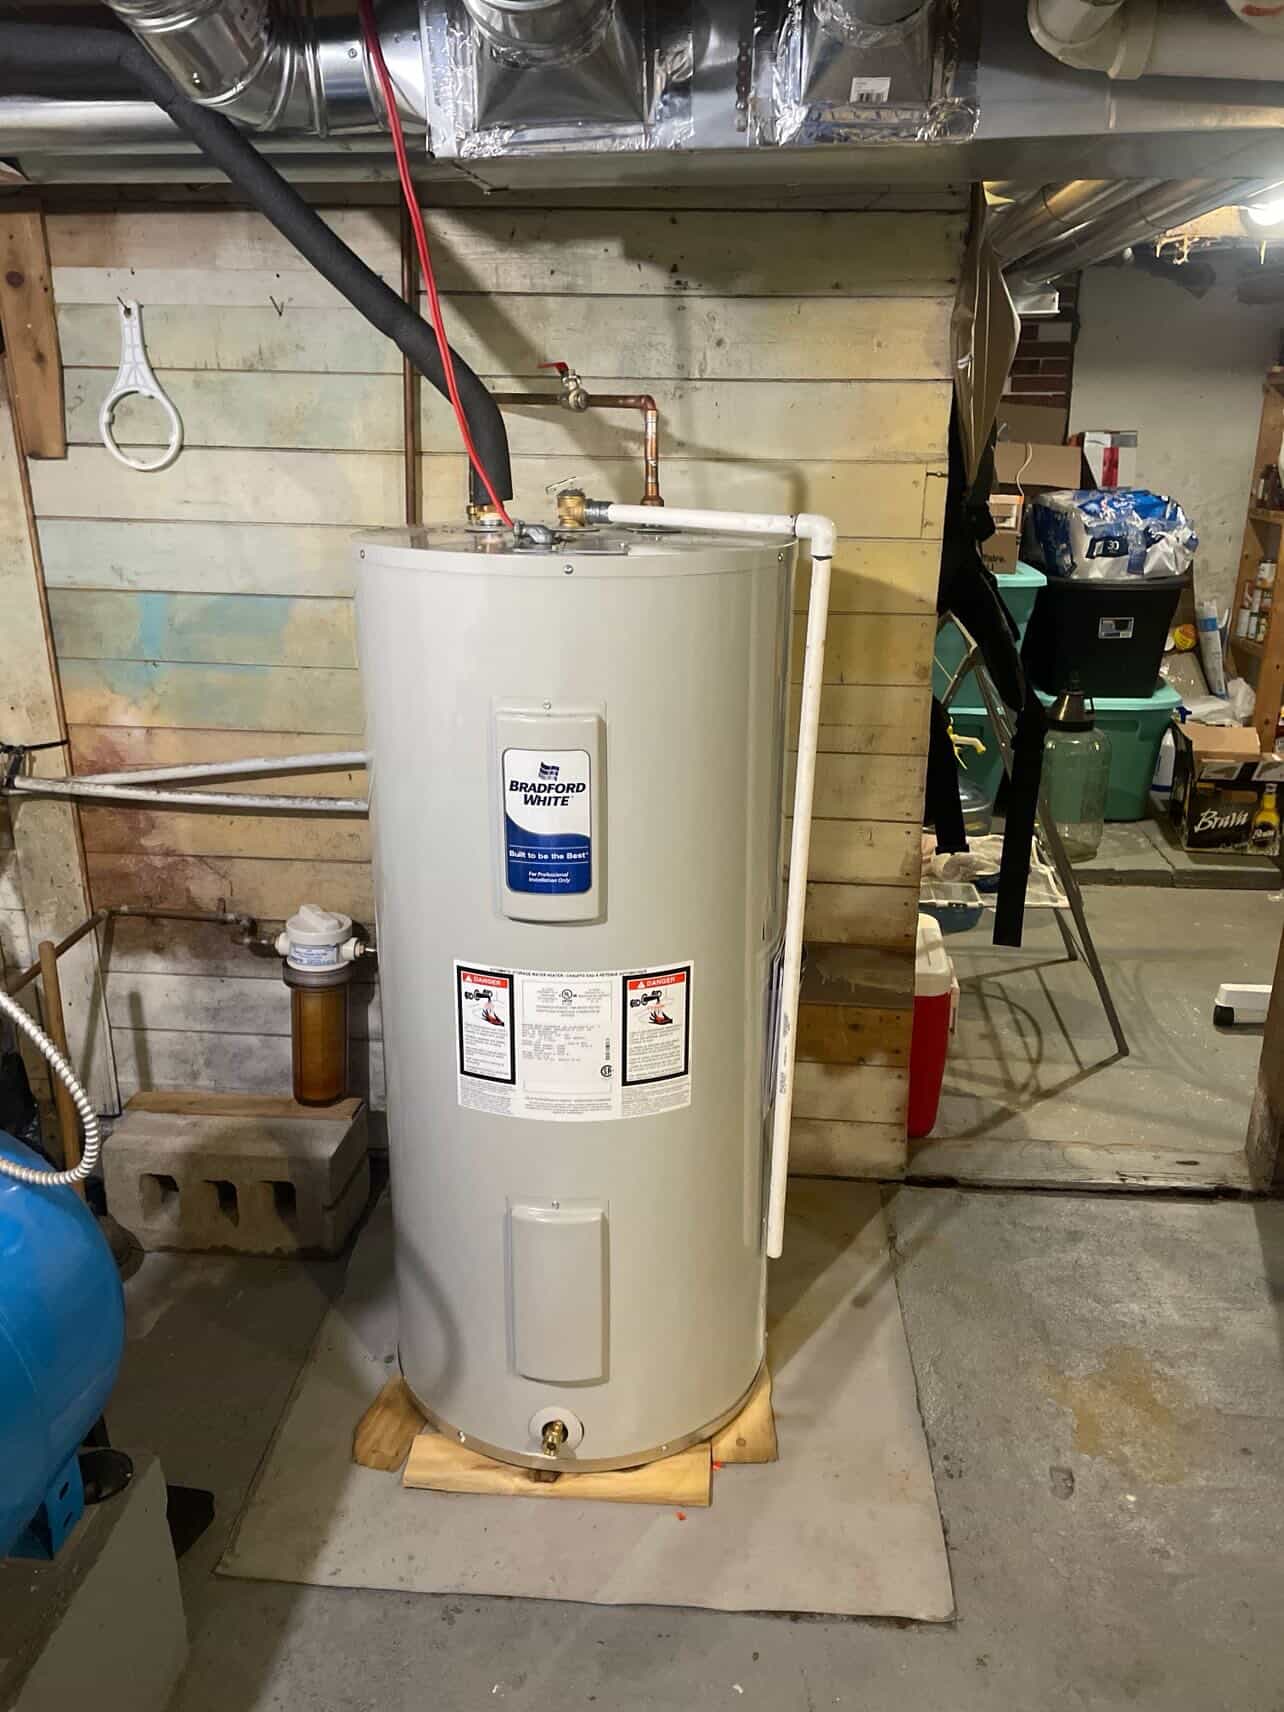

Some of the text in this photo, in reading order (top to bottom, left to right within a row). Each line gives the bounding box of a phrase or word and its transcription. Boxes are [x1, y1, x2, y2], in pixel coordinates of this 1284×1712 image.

[1107, 540, 1120, 550] 30
[509, 780, 586, 794] BRADFORD
[523, 794, 570, 806] WHITE
[509, 850, 526, 859] Built
[473, 975, 501, 986] DANGER
[646, 976, 676, 987] DANGER
